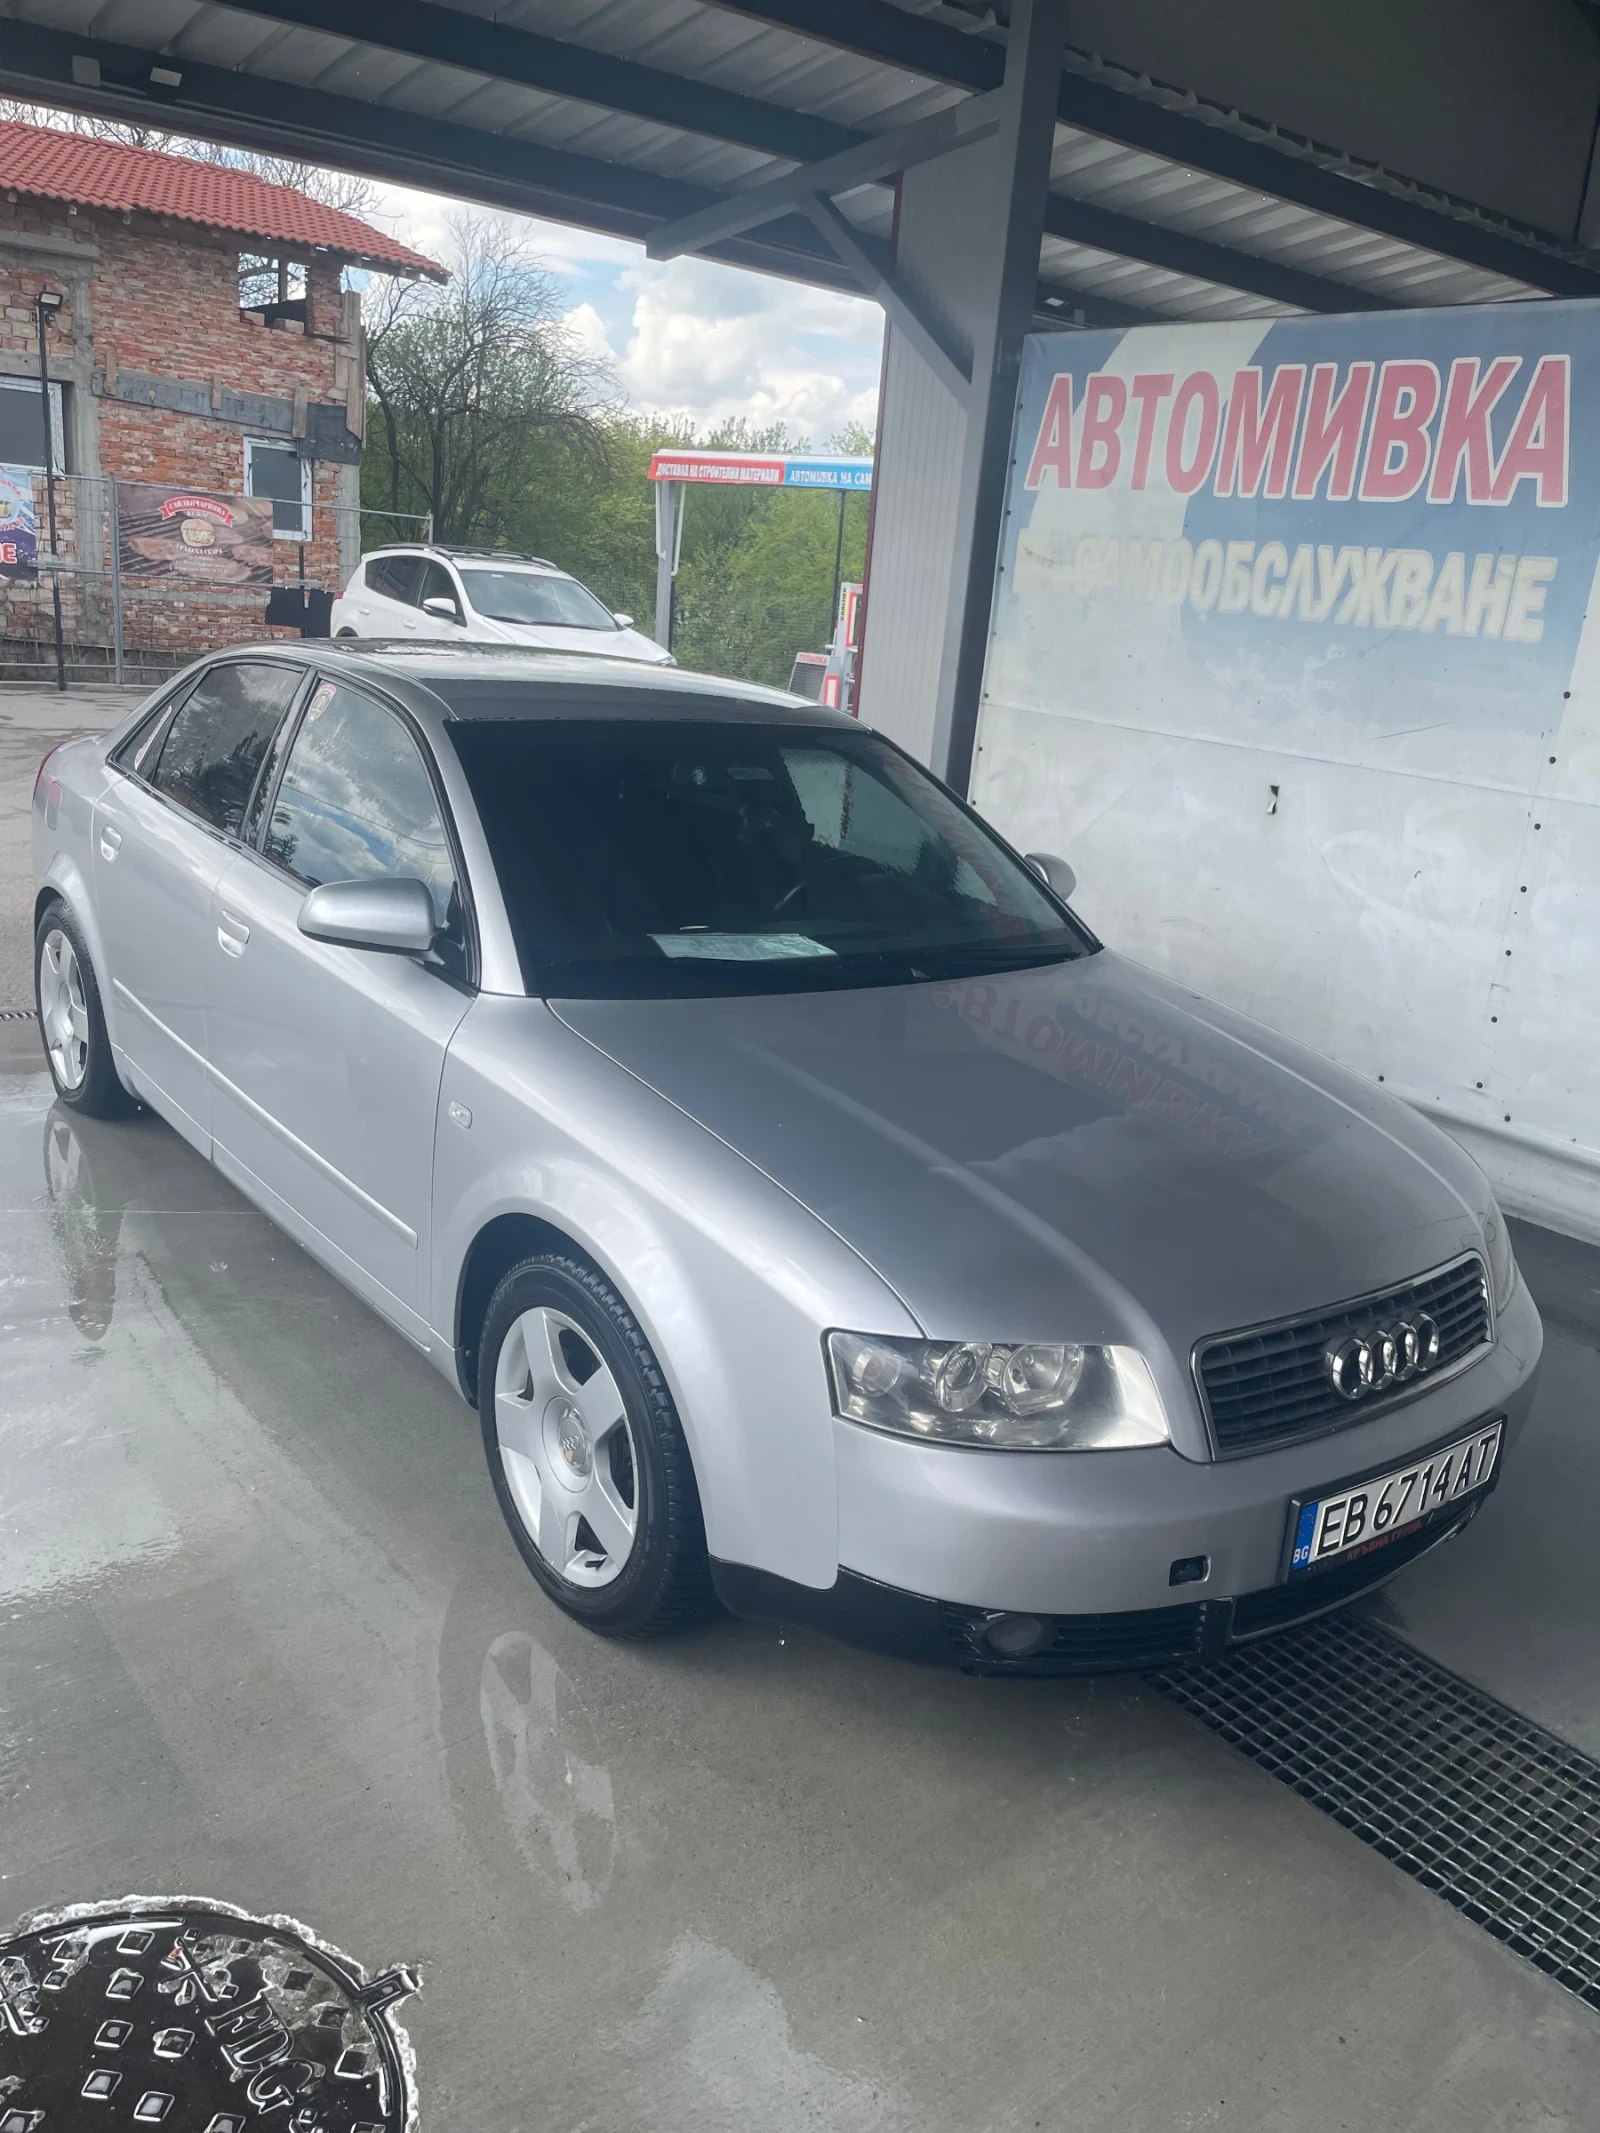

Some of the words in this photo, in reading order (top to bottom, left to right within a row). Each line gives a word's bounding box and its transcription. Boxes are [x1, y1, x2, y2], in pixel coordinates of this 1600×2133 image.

[1024, 354, 1570, 508] АВТОМИВКА
[656, 462, 688, 477] ДОСТАВКА
[689, 465, 698, 478] НА
[740, 467, 780, 482] МАТЕРИАЛИ
[789, 469, 837, 484] АВТОМИВКА
[840, 471, 851, 484] НА
[1314, 1492, 1369, 1557] EB
[1371, 1452, 1455, 1531] 6714
[1450, 1431, 1497, 1495] AT
[1293, 1545, 1309, 1564] BG
